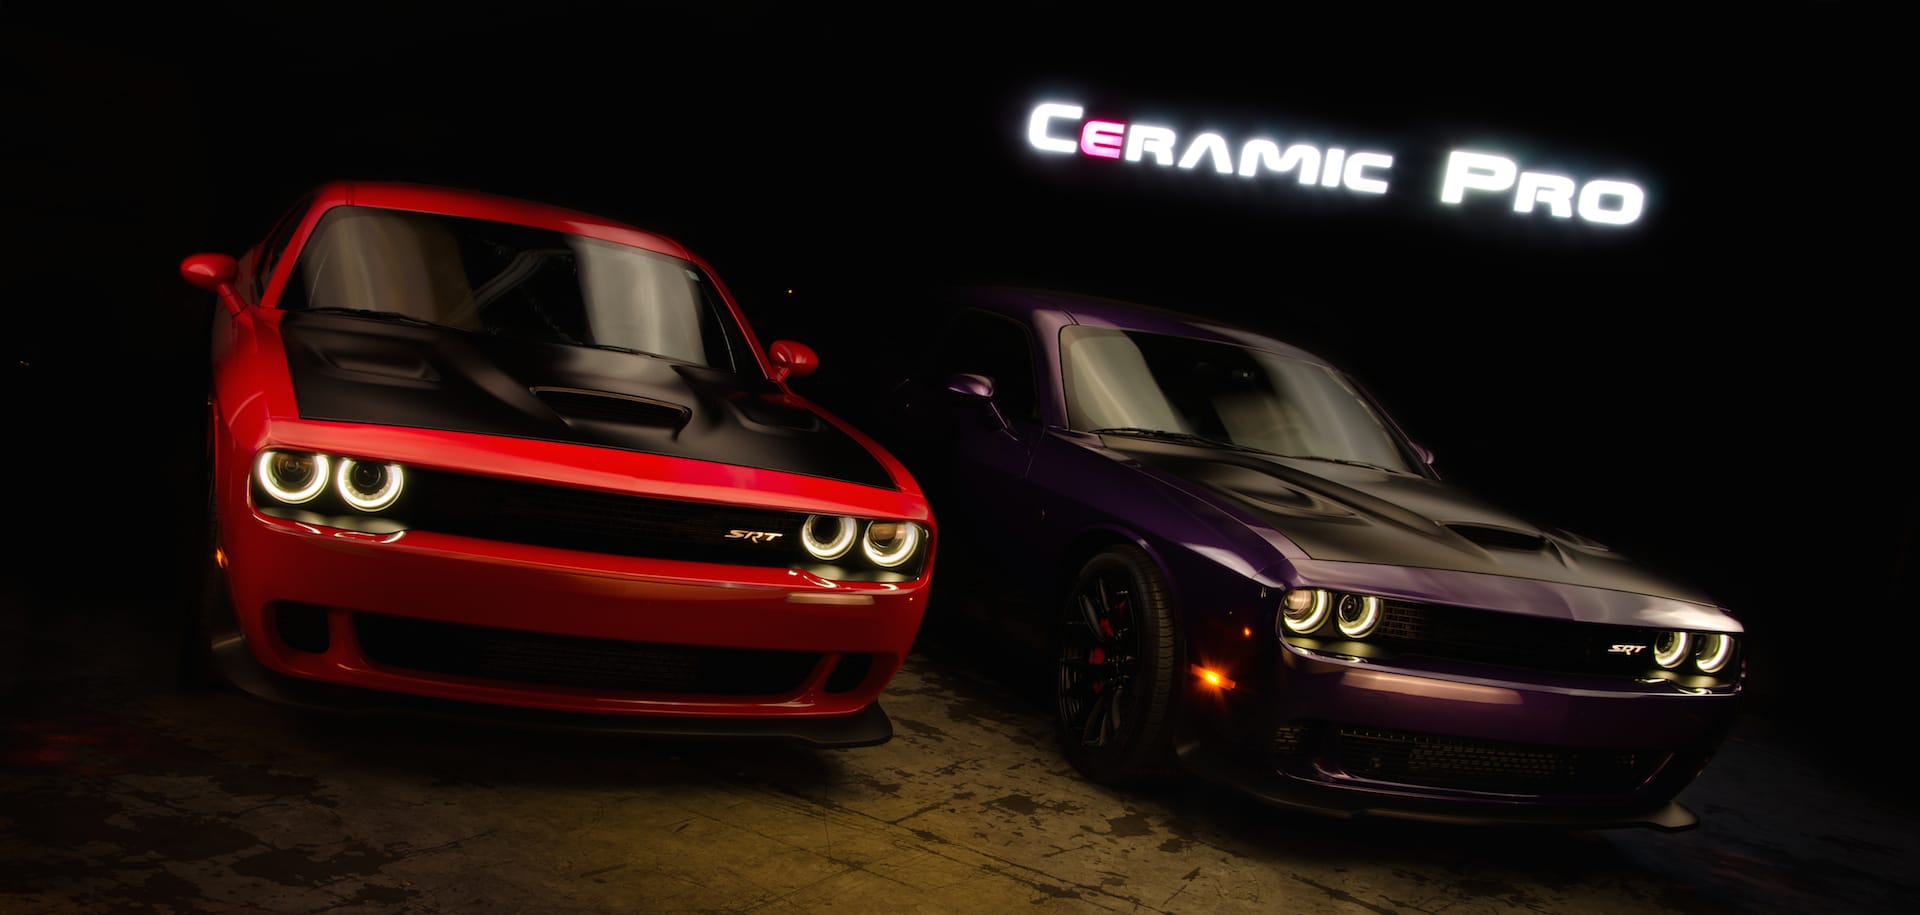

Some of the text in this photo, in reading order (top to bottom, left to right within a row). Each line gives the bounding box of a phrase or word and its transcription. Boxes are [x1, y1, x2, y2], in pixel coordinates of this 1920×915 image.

[1027, 103, 1646, 225] CERAMIC PRO
[724, 530, 783, 543] SRT
[1608, 645, 1647, 655] SRT
